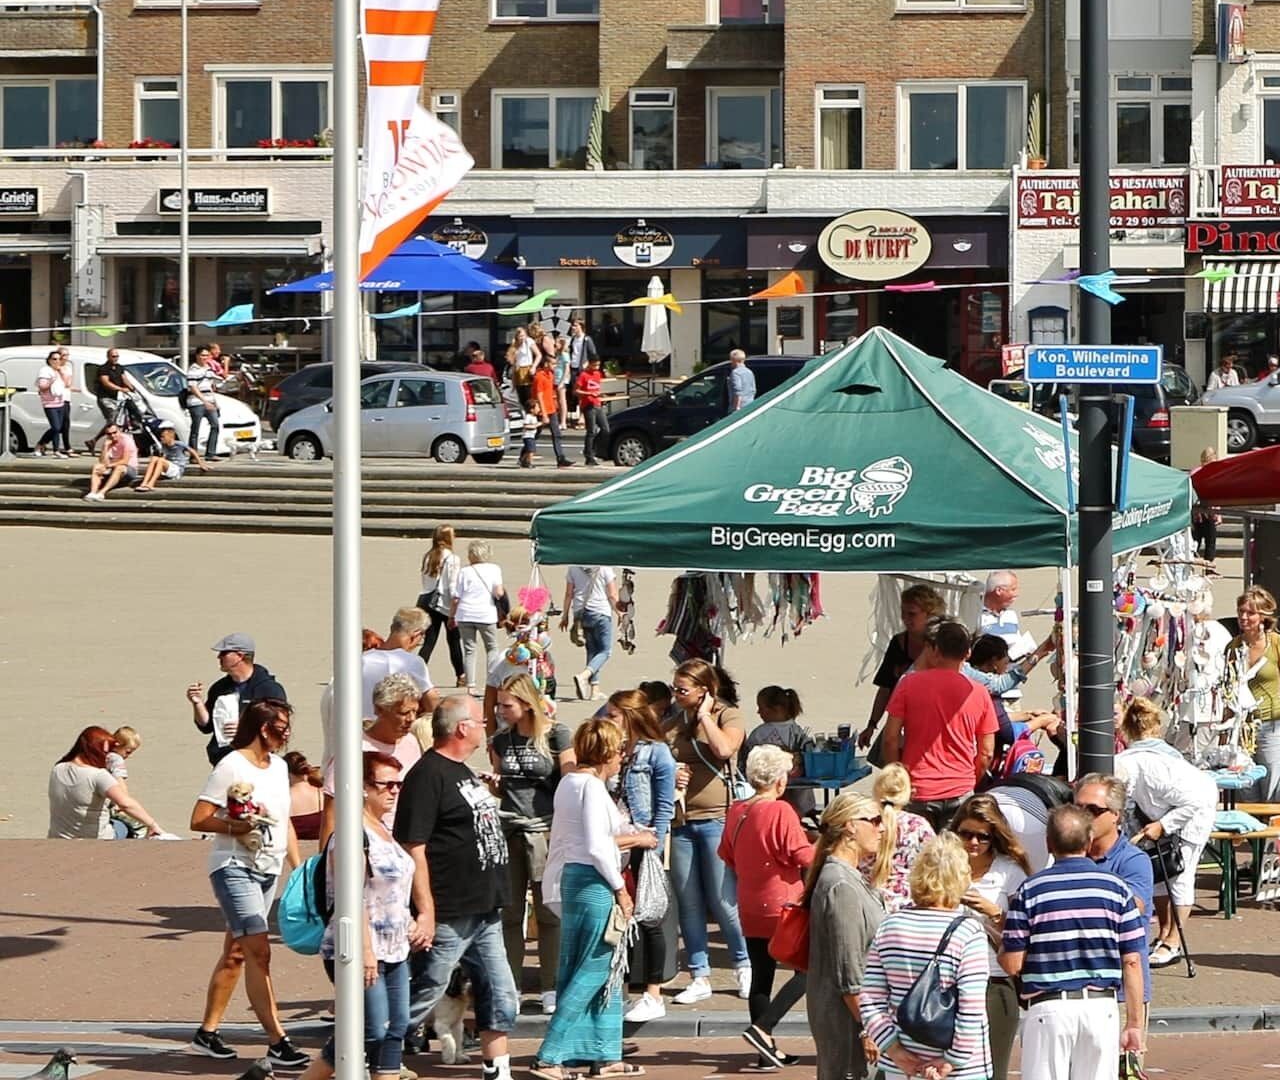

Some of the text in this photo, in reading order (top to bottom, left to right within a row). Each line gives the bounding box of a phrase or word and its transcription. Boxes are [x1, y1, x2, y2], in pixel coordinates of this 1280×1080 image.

[1020, 179, 1080, 189] AUTHENTIEK
[1122, 178, 1184, 189] RESTAURANT
[231, 191, 265, 204] Grietje
[1039, 191, 1167, 215] Taj ahal
[1110, 217, 1122, 225] 62
[1126, 217, 1139, 225] 29
[1142, 217, 1155, 225] 90
[845, 238, 911, 258] DE WURFT
[1037, 351, 1070, 364] Kon.
[1072, 350, 1149, 364] Wilhelmina
[1056, 365, 1130, 377] Boulevard
[799, 466, 857, 489] Big
[744, 484, 847, 502] Green
[774, 500, 843, 517] Egg
[711, 526, 896, 553] BigGreenEgg.com
